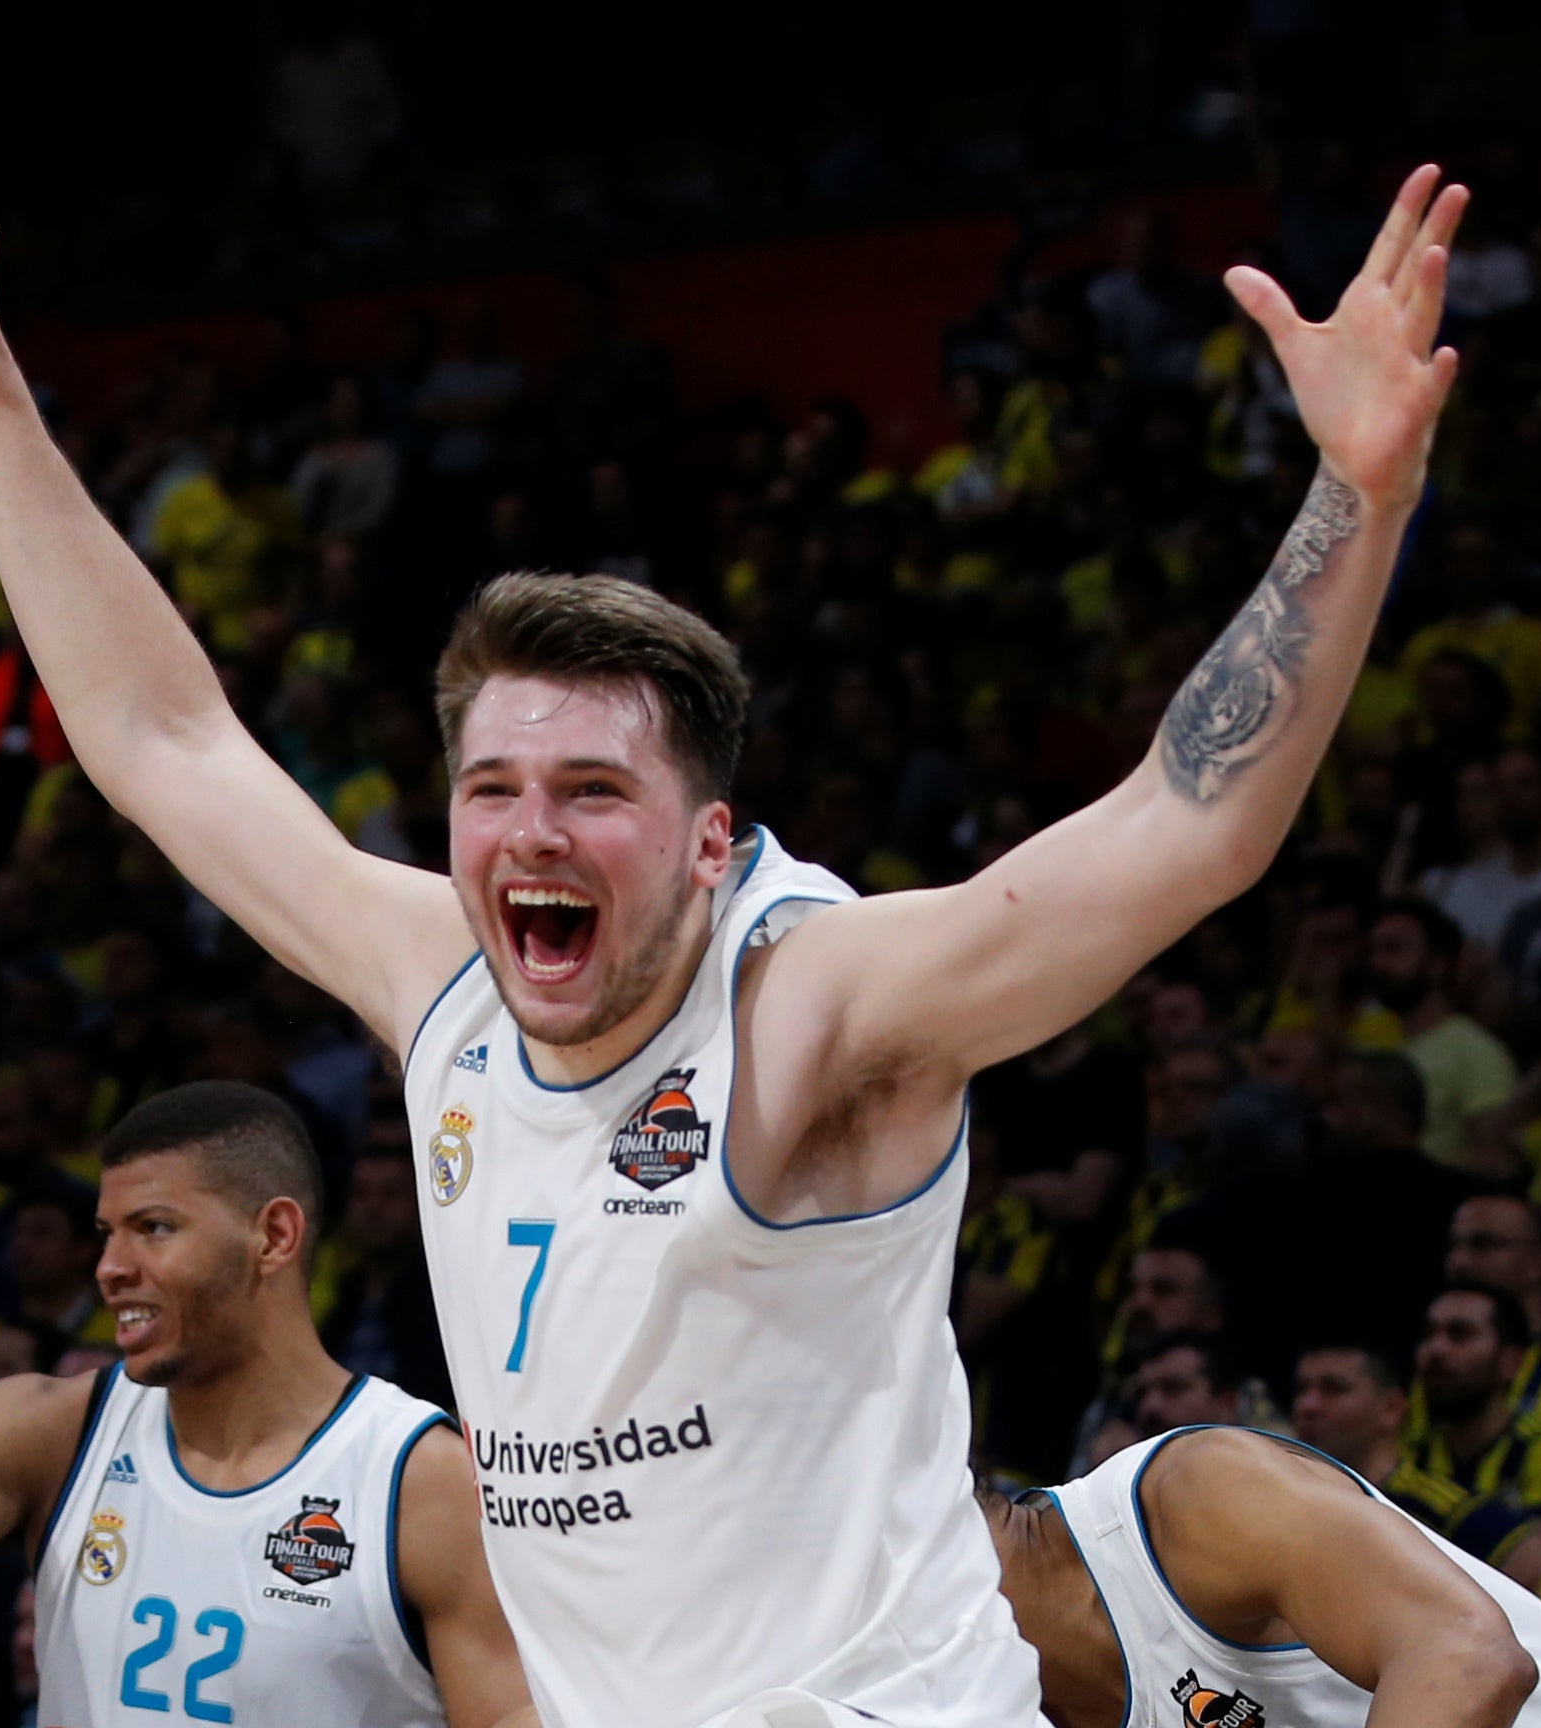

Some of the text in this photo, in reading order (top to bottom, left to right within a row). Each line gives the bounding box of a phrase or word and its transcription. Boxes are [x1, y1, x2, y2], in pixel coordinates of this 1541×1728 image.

[612, 1129, 705, 1157] FINAL FOUR
[603, 1196, 686, 1216] oneteam
[505, 1217, 557, 1373] 7
[475, 1403, 713, 1476] Universidad
[481, 1485, 632, 1536] Europea
[268, 1537, 351, 1565] FINAL FOUR
[262, 1587, 332, 1609] oneteam
[120, 1593, 245, 1725] 22
